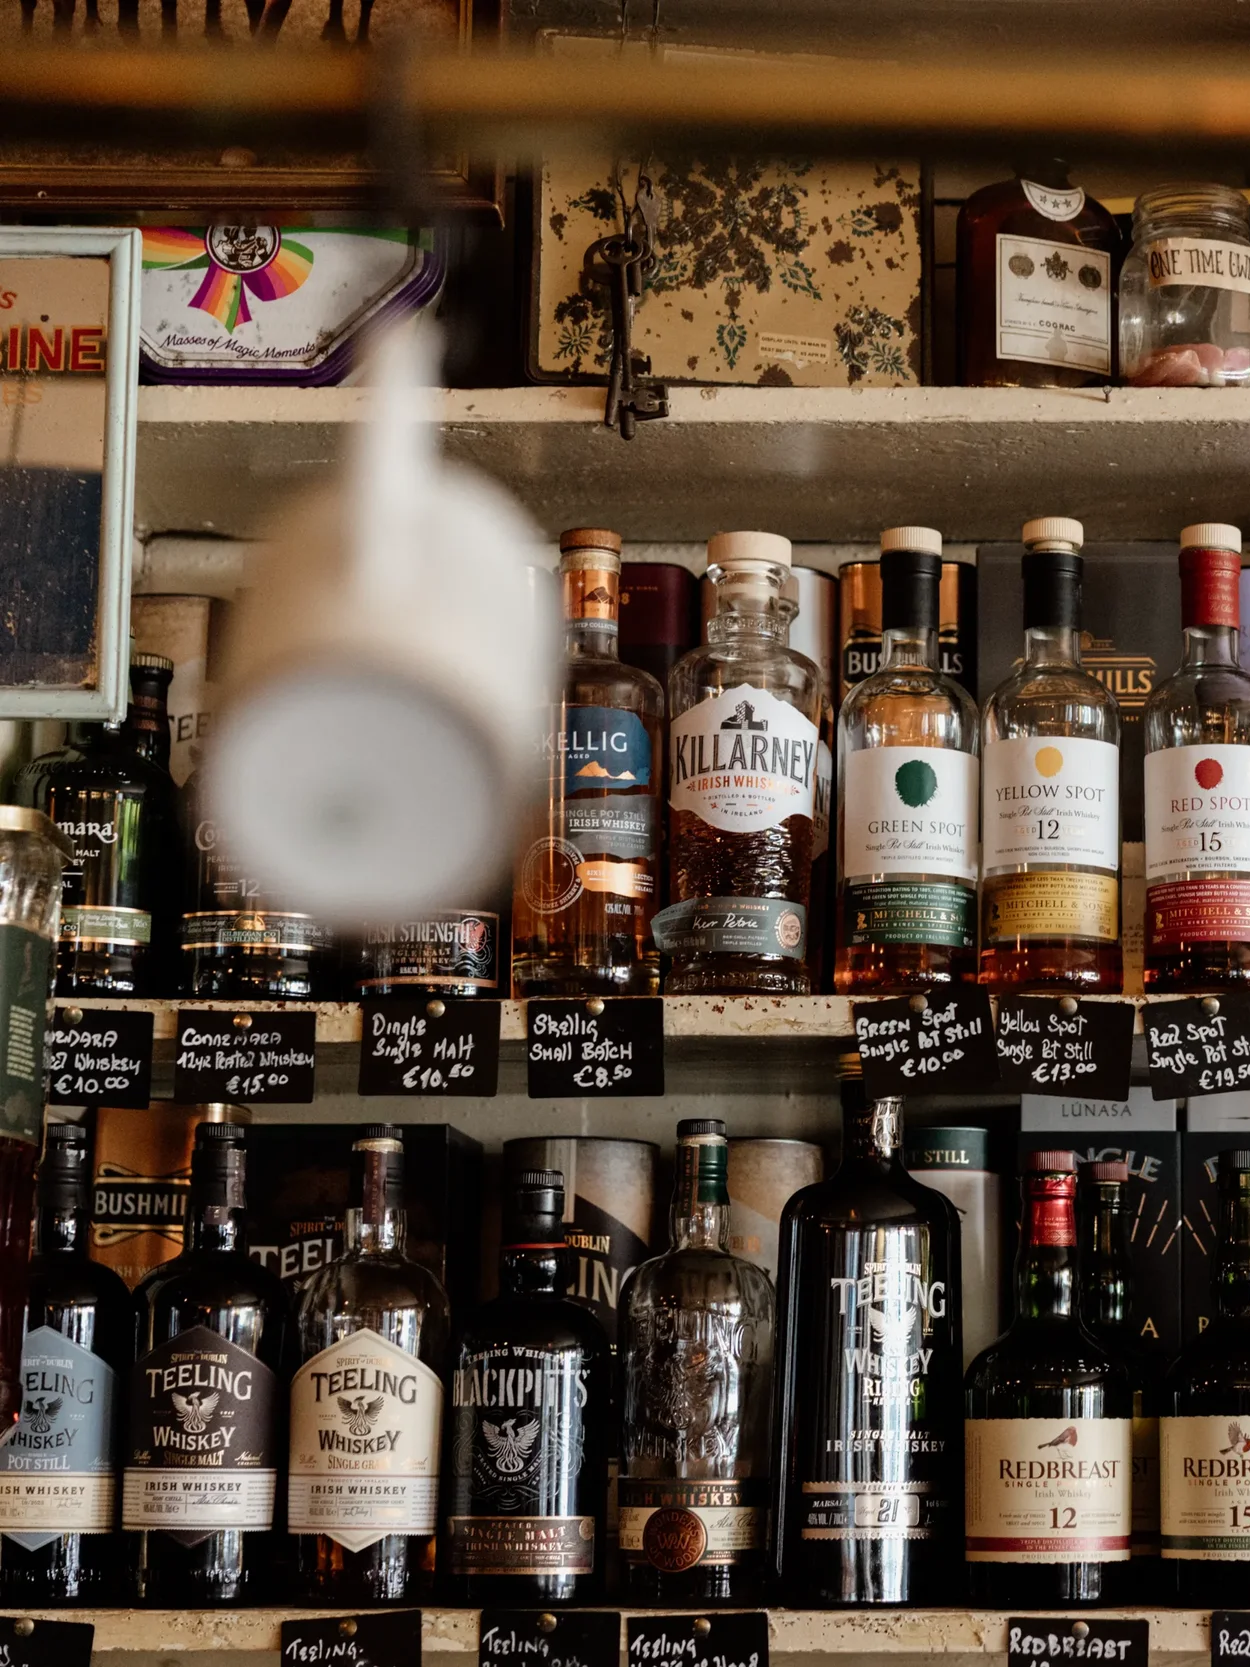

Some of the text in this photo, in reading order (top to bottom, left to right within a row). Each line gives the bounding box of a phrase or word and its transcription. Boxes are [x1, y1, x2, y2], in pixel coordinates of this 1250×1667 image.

[1151, 250, 1184, 279] ONE
[1187, 248, 1224, 275] TIME
[1039, 320, 1076, 332] COGNAC
[159, 334, 316, 360] Masses of Magic Moments
[676, 734, 814, 788] KILLARNEY
[697, 776, 731, 791] IRISH
[996, 784, 1105, 802] YELLOW SPOT
[1170, 796, 1204, 812] RED
[569, 818, 646, 831] IRISH WHISKEY
[868, 820, 966, 837] GREEN SPOT
[1036, 819, 1060, 840] 12
[1199, 832, 1222, 852] 15
[1169, 906, 1230, 918] MITCHELL
[573, 1065, 632, 1089] €8.50
[1062, 1102, 1133, 1117] LÚNASA
[924, 1150, 970, 1164] STILL
[845, 1348, 934, 1378] WHISKEY
[146, 1363, 252, 1401] TEELING
[310, 1368, 418, 1405] TEELING
[152, 1425, 236, 1451] WHISKEY
[318, 1429, 402, 1456] WHISKEY
[34, 1455, 71, 1470] STILL
[999, 1459, 1119, 1479] REDBREAST
[25, 1486, 86, 1495] WHISKEY
[145, 1482, 241, 1492] IRISH WHISKEY
[310, 1485, 407, 1495] IRISH WHISKEY
[1004, 1481, 1049, 1489] SINGLE
[1214, 1488, 1235, 1498] Irish
[1034, 1489, 1093, 1500] Irish Whiskey
[1049, 1507, 1078, 1530] 12
